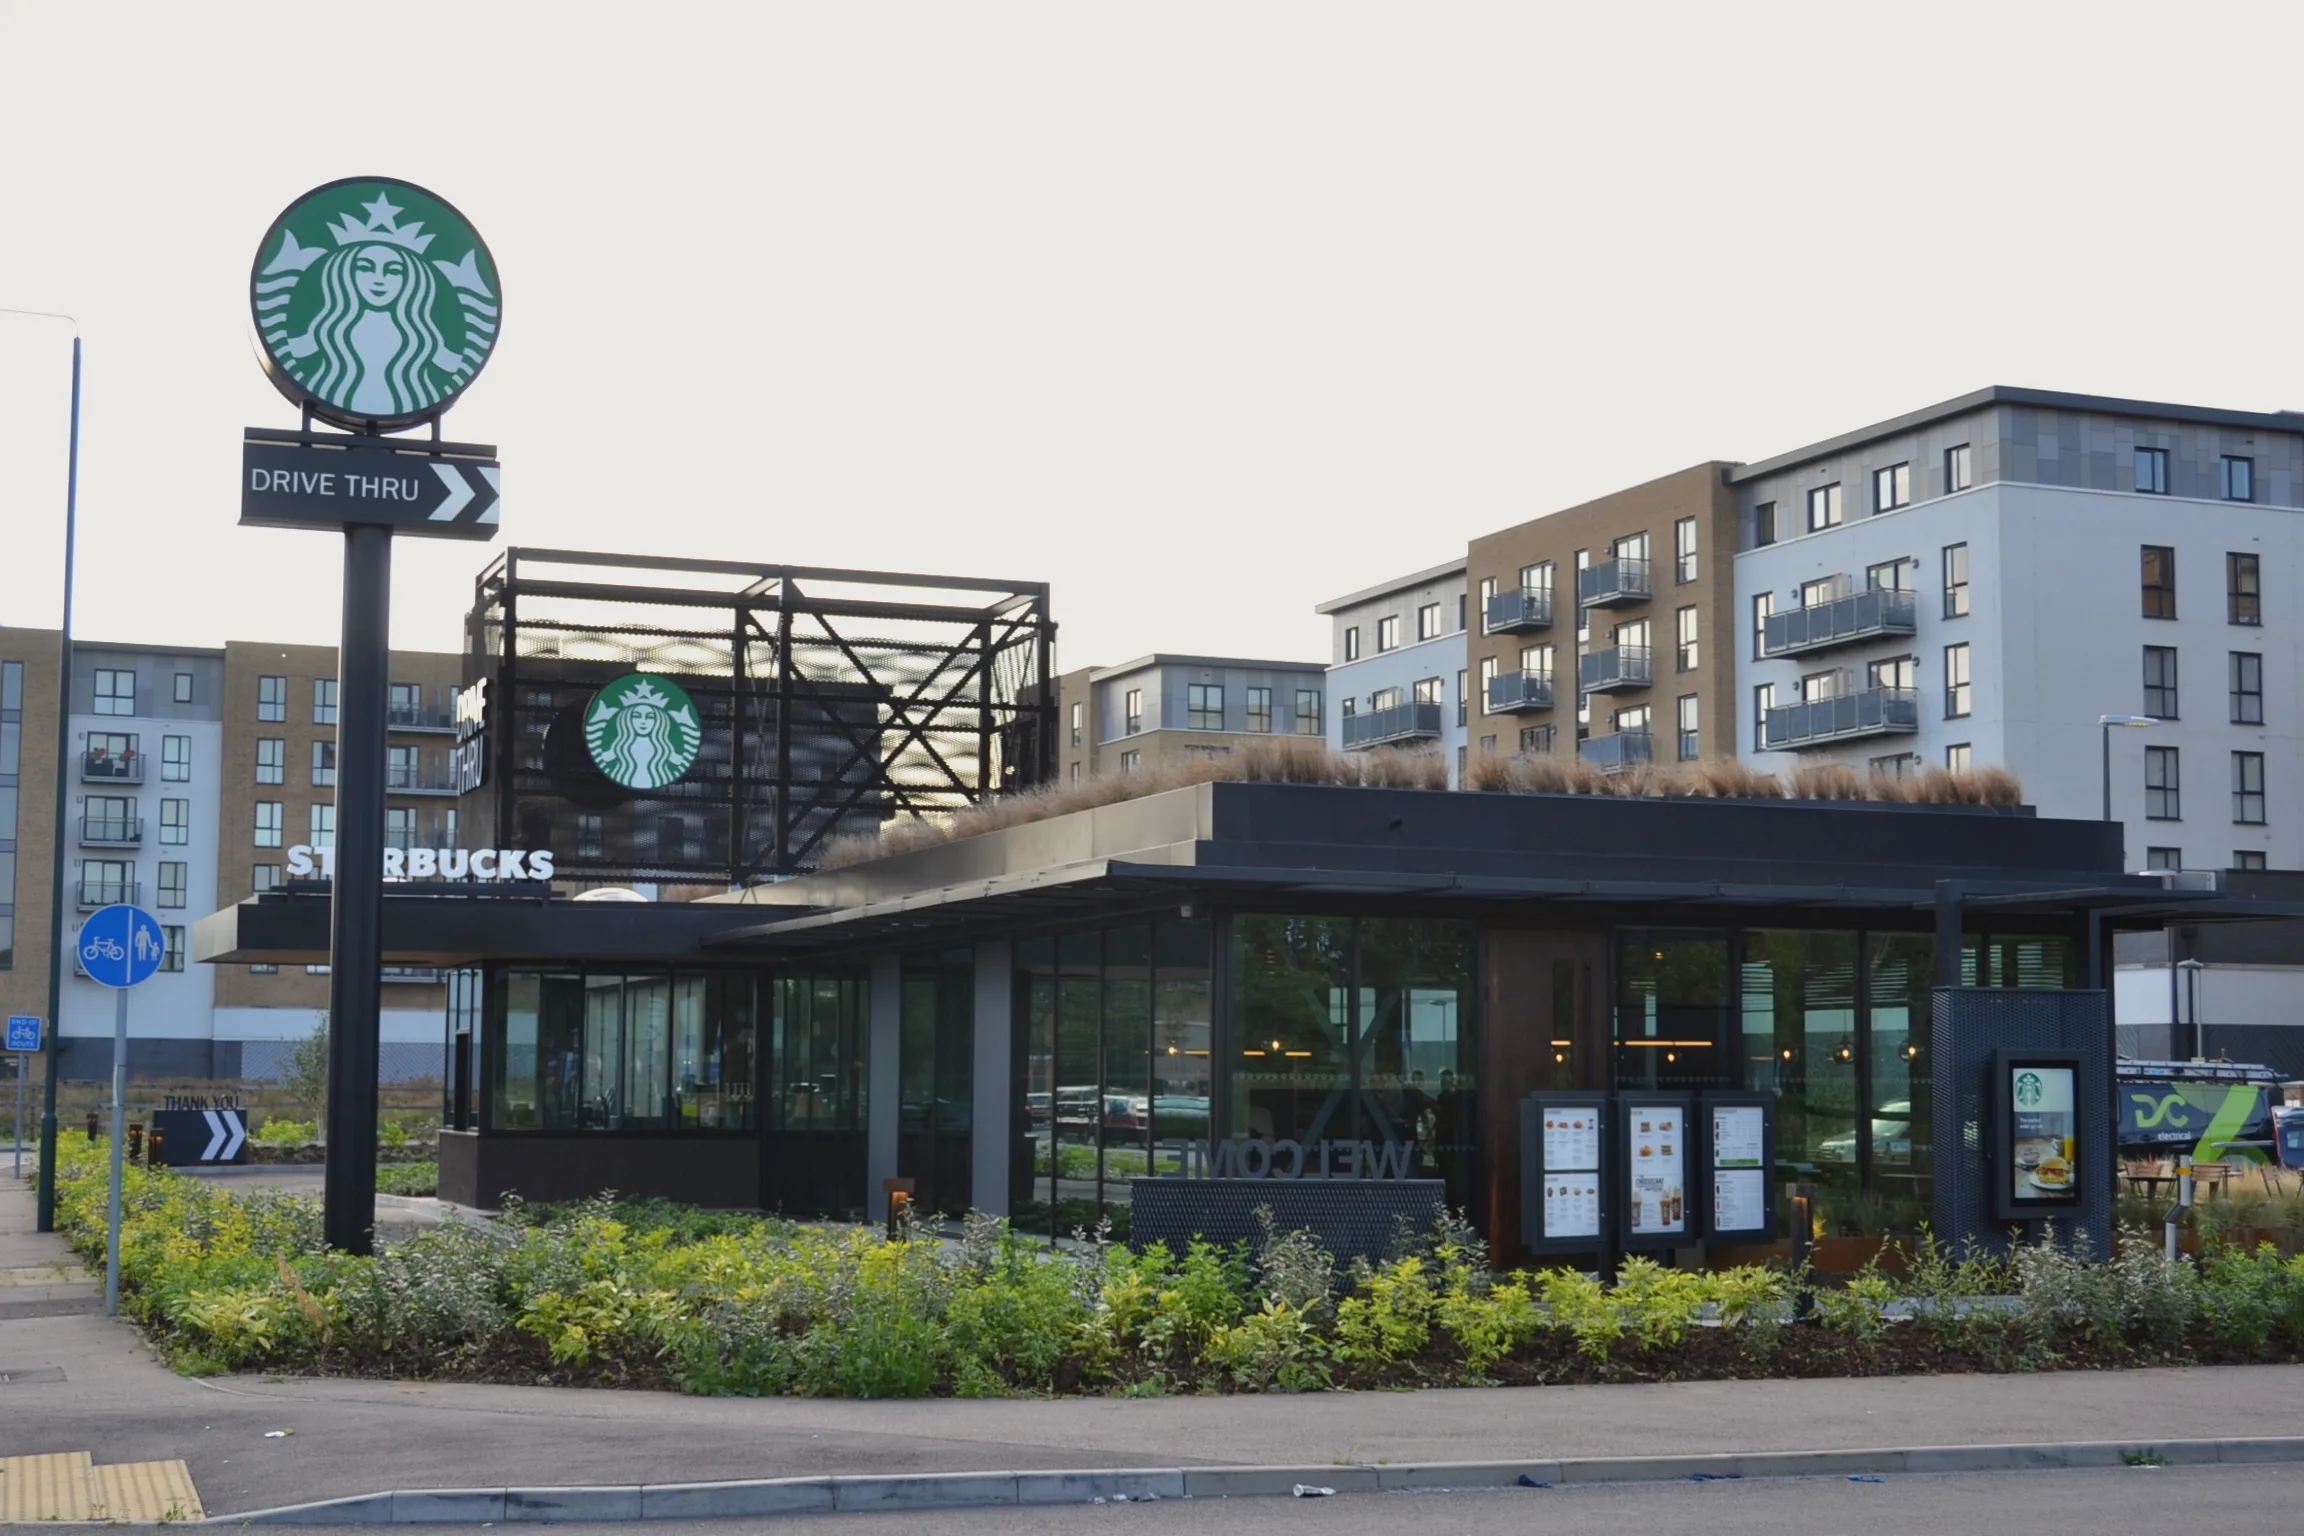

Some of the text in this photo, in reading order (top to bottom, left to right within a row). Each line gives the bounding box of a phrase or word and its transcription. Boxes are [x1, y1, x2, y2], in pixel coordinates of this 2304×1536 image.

[251, 468, 420, 502] DRIVE THRU
[456, 676, 488, 744] DRIVE
[456, 733, 484, 797] THRU
[286, 844, 556, 882] STRBUCKS
[163, 1095, 239, 1110] THANK YOU
[2130, 1093, 2190, 1129] DC
[2157, 1130, 2192, 1141] electrical
